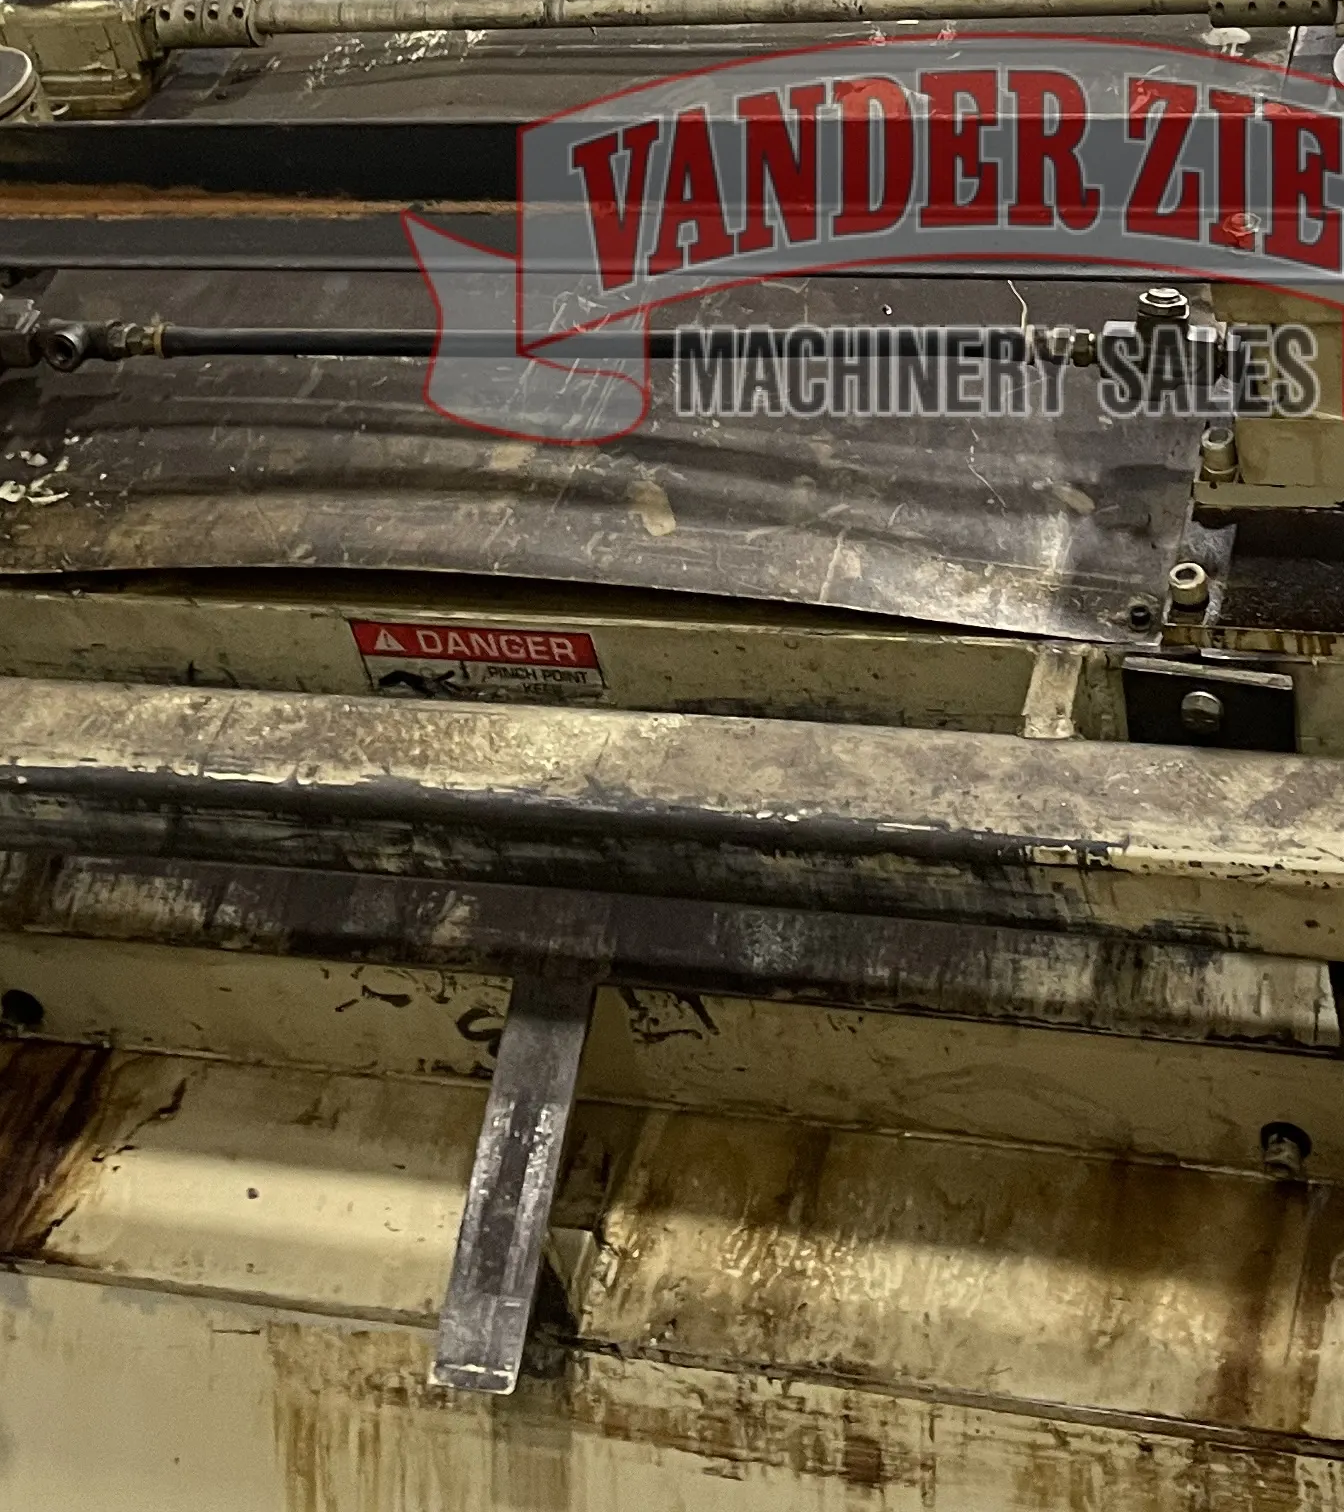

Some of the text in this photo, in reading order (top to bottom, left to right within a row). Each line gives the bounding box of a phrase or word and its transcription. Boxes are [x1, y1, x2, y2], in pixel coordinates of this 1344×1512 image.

[416, 629, 577, 662] DANGER
[487, 666, 587, 684] PINCH POINT
